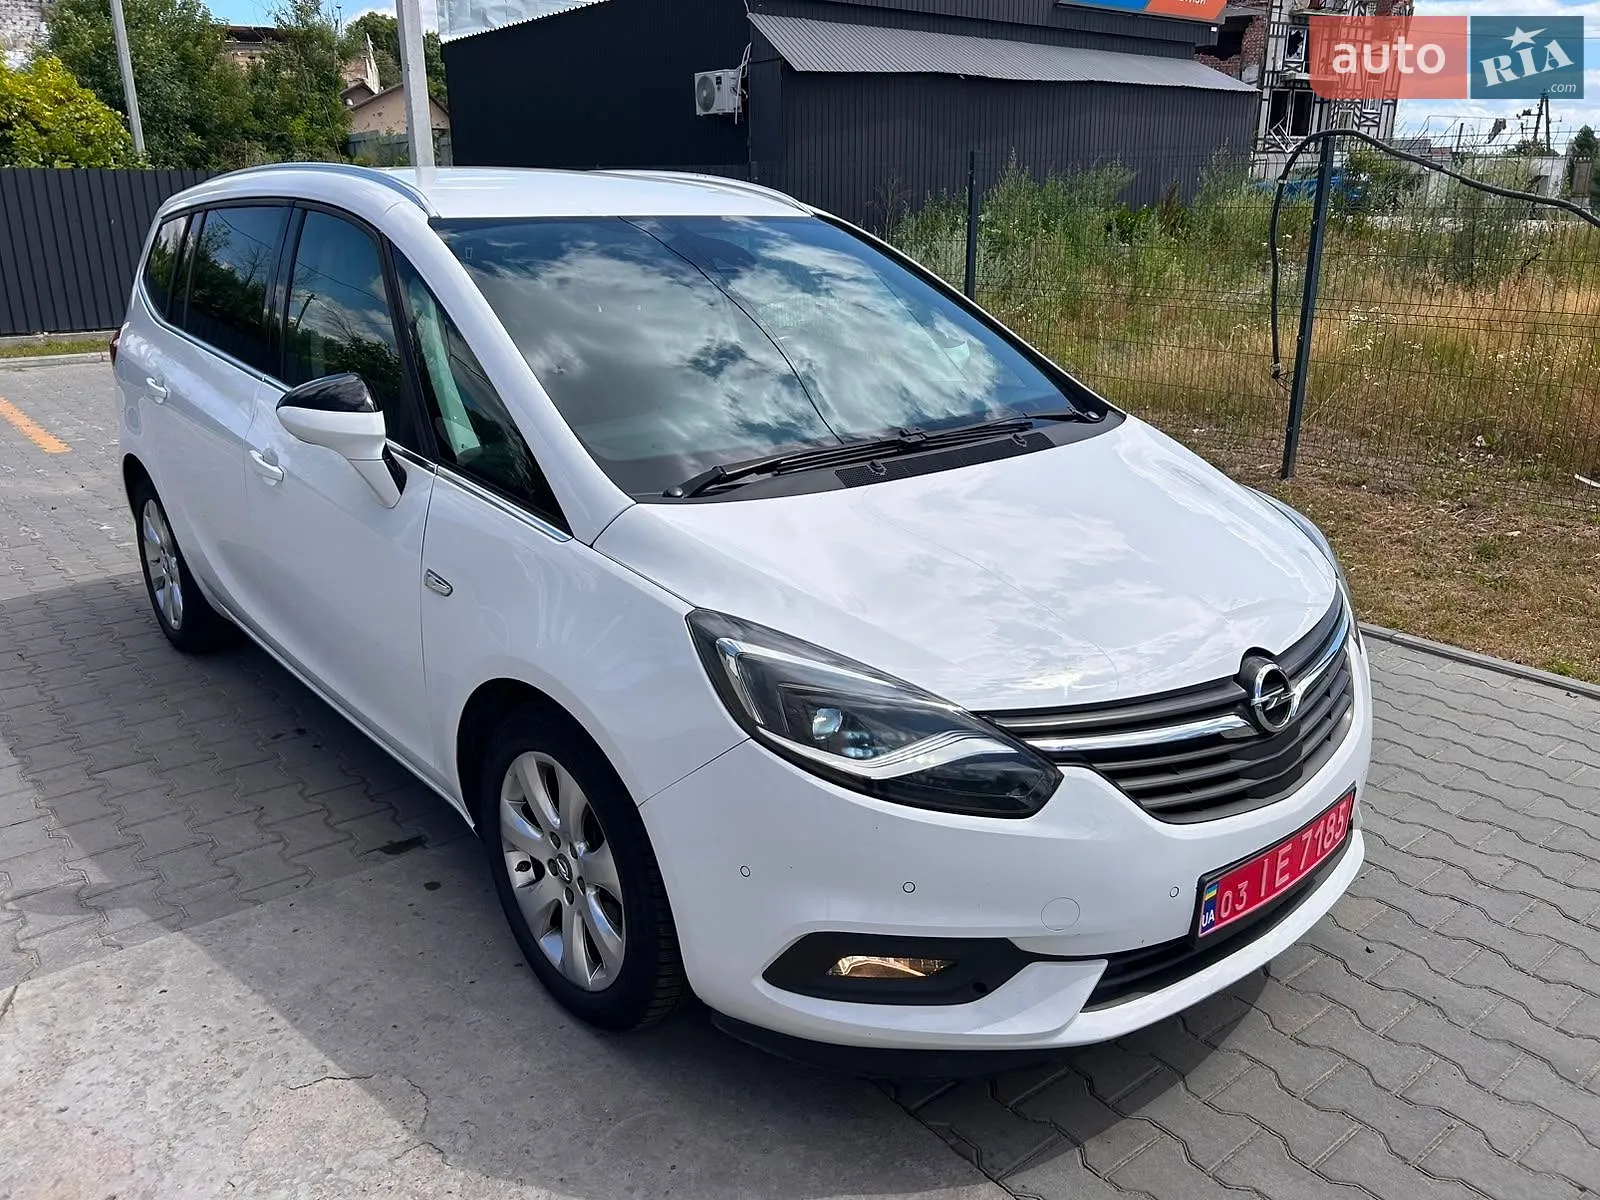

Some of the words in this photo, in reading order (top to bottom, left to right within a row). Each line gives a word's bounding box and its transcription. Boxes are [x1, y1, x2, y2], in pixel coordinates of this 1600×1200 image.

[1220, 880, 1249, 919] 03
[1259, 844, 1292, 897] IE
[1300, 800, 1347, 871] 7185
[1202, 911, 1215, 927] UA
